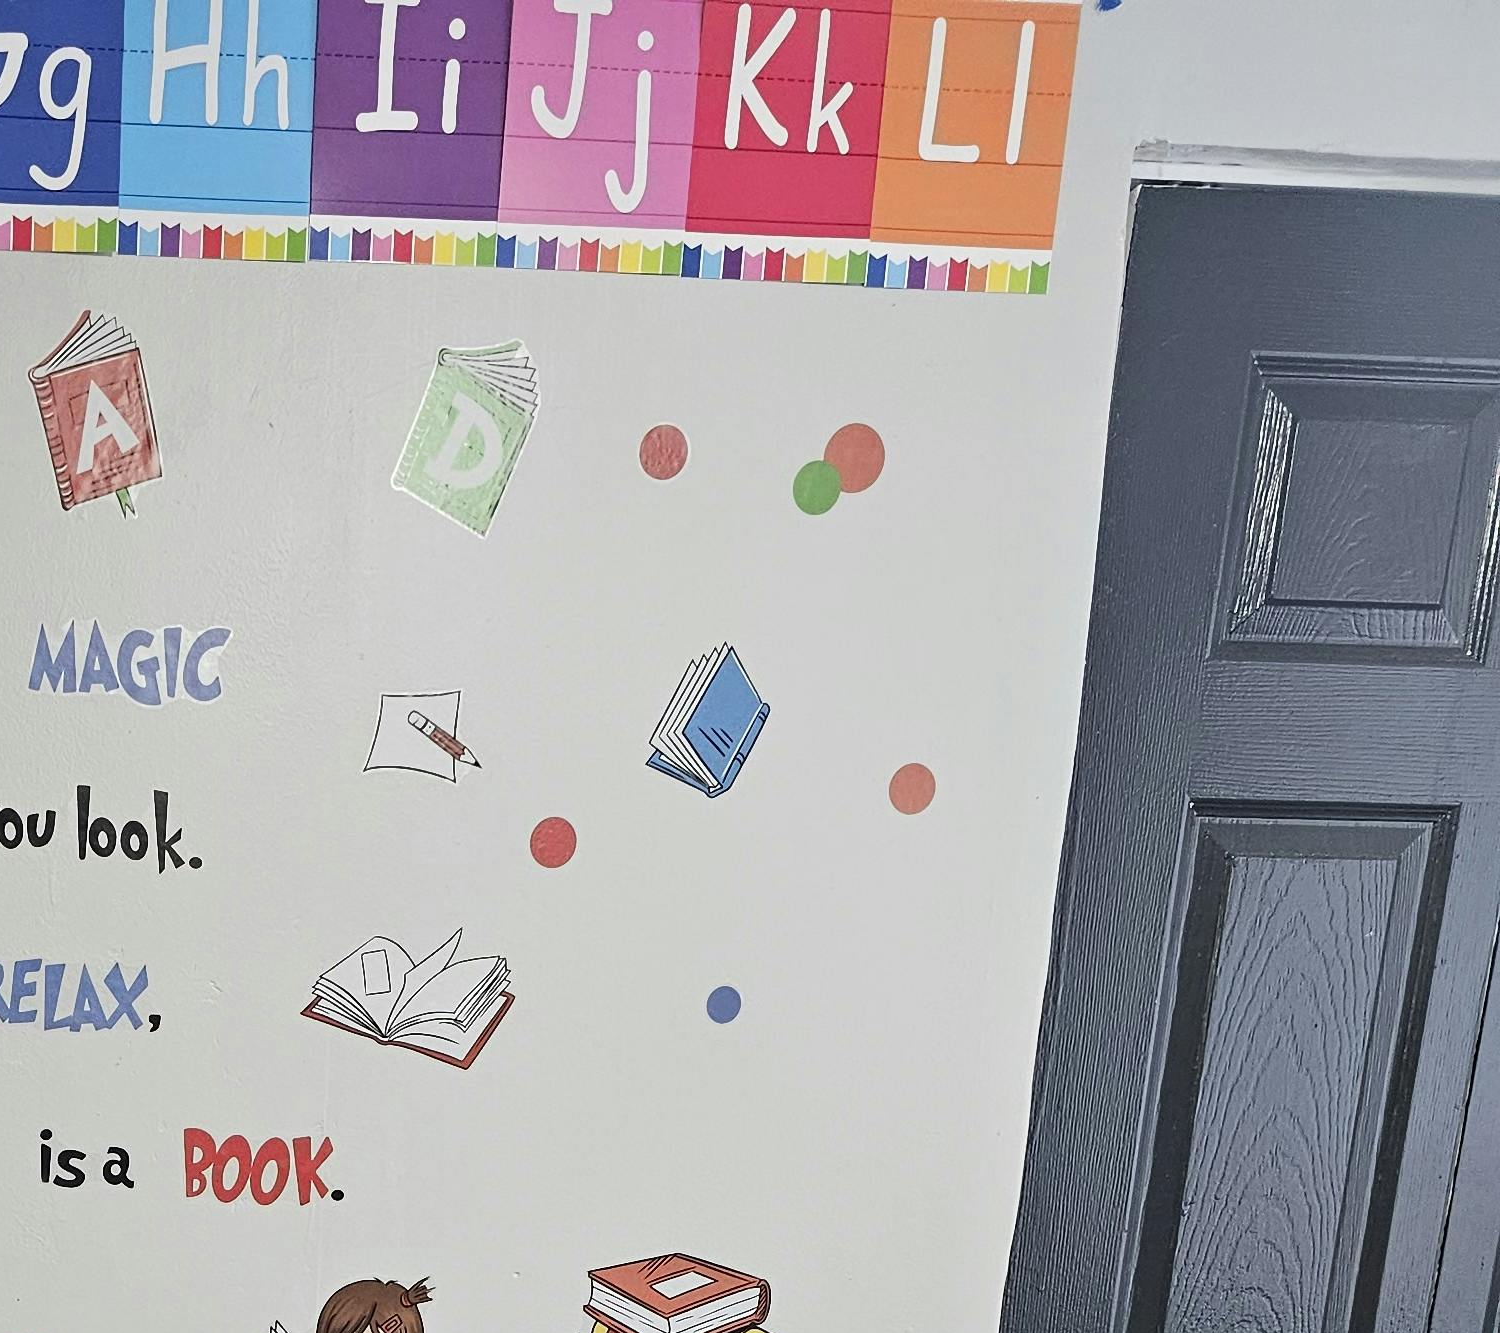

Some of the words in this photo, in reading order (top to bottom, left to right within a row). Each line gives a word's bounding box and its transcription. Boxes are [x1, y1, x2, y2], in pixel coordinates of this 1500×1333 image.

[75, 382, 140, 475] A
[432, 393, 505, 488] D
[27, 620, 233, 706] MAGIC
[76, 785, 203, 874] look.
[39, 1128, 87, 1187] is
[105, 1145, 135, 1188] a
[184, 1126, 345, 1206] BOOK.
